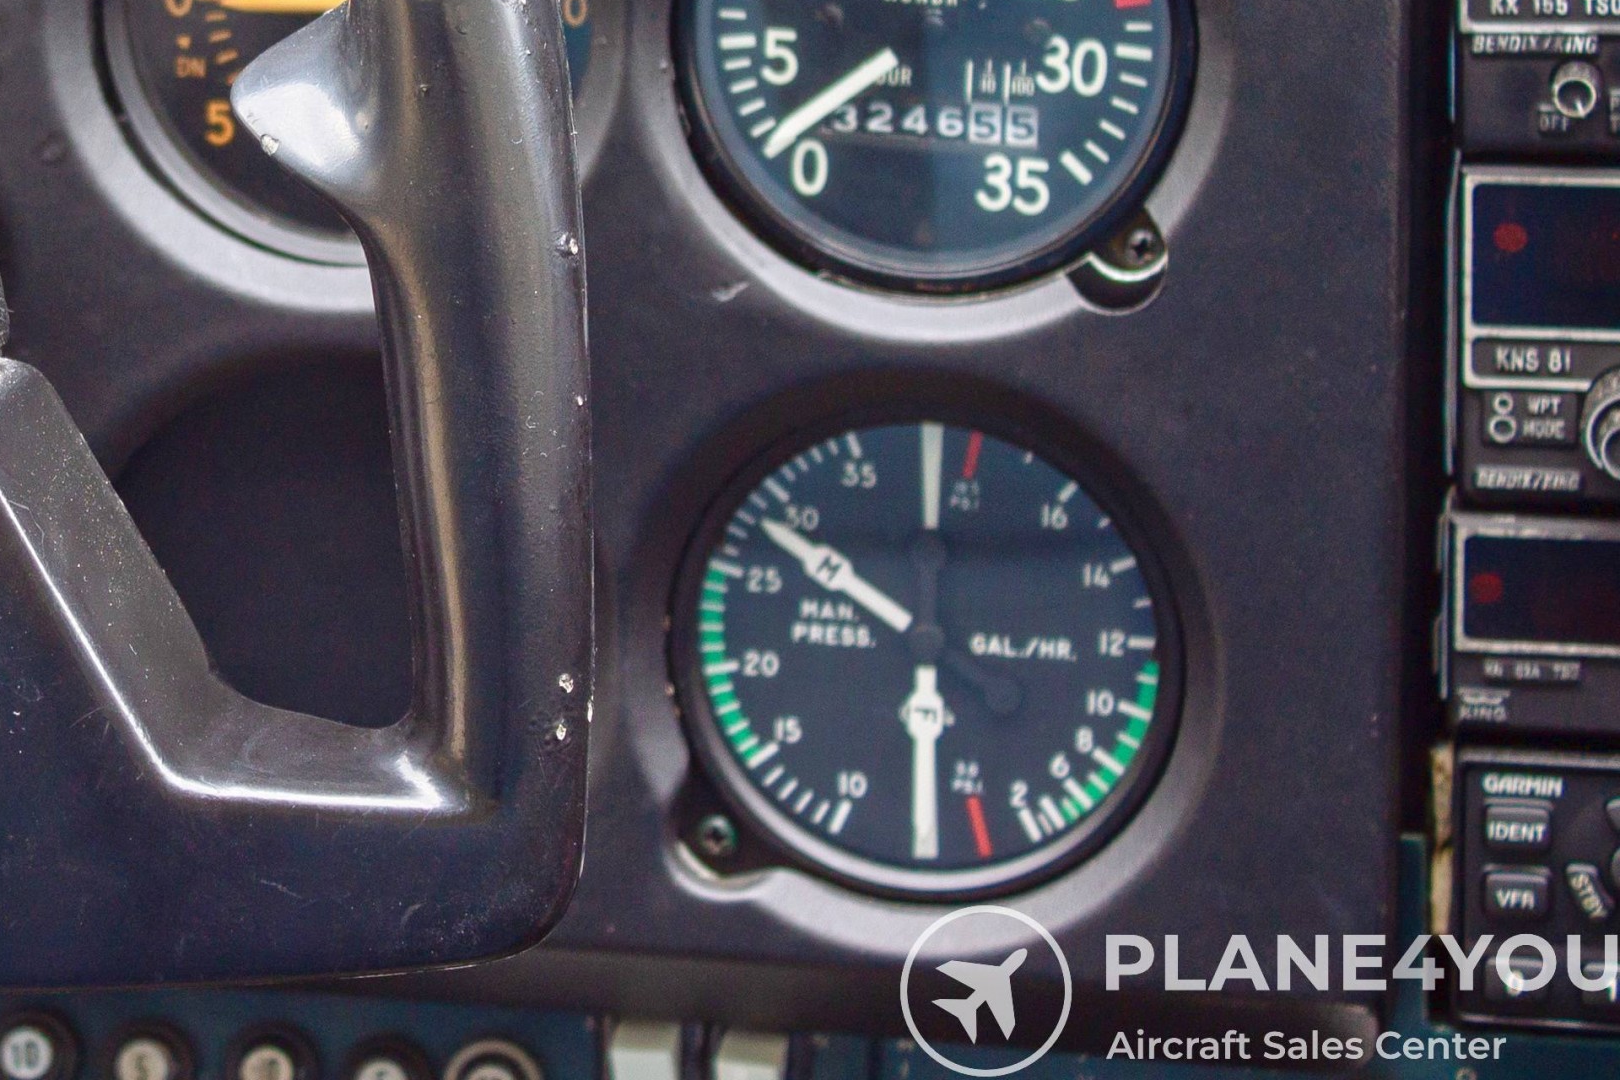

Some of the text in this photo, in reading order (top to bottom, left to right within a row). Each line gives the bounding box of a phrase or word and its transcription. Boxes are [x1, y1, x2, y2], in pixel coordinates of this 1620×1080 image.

[761, 27, 799, 85] 5
[1036, 36, 1108, 96] 30
[876, 65, 913, 87] OUR
[206, 100, 235, 146] 5
[792, 140, 829, 197] 0
[975, 153, 1051, 216] 35
[1495, 347, 1540, 372] KNS
[841, 463, 878, 489] 35
[1040, 505, 1068, 530] 16
[747, 567, 783, 594] 25
[1082, 564, 1110, 589] 14
[799, 599, 860, 621] MAN.
[792, 622, 876, 648] PRESS.
[1098, 631, 1127, 656] 12
[743, 653, 780, 677] 20
[1087, 692, 1115, 717] 10
[775, 718, 802, 744] 15
[1076, 730, 1094, 752] 8
[1050, 755, 1070, 779] 6
[837, 772, 868, 798] 10
[1009, 783, 1028, 807] 2
[1482, 774, 1563, 798] GARMIN
[1486, 821, 1547, 842] IDENT
[1495, 889, 1536, 910] VFR
